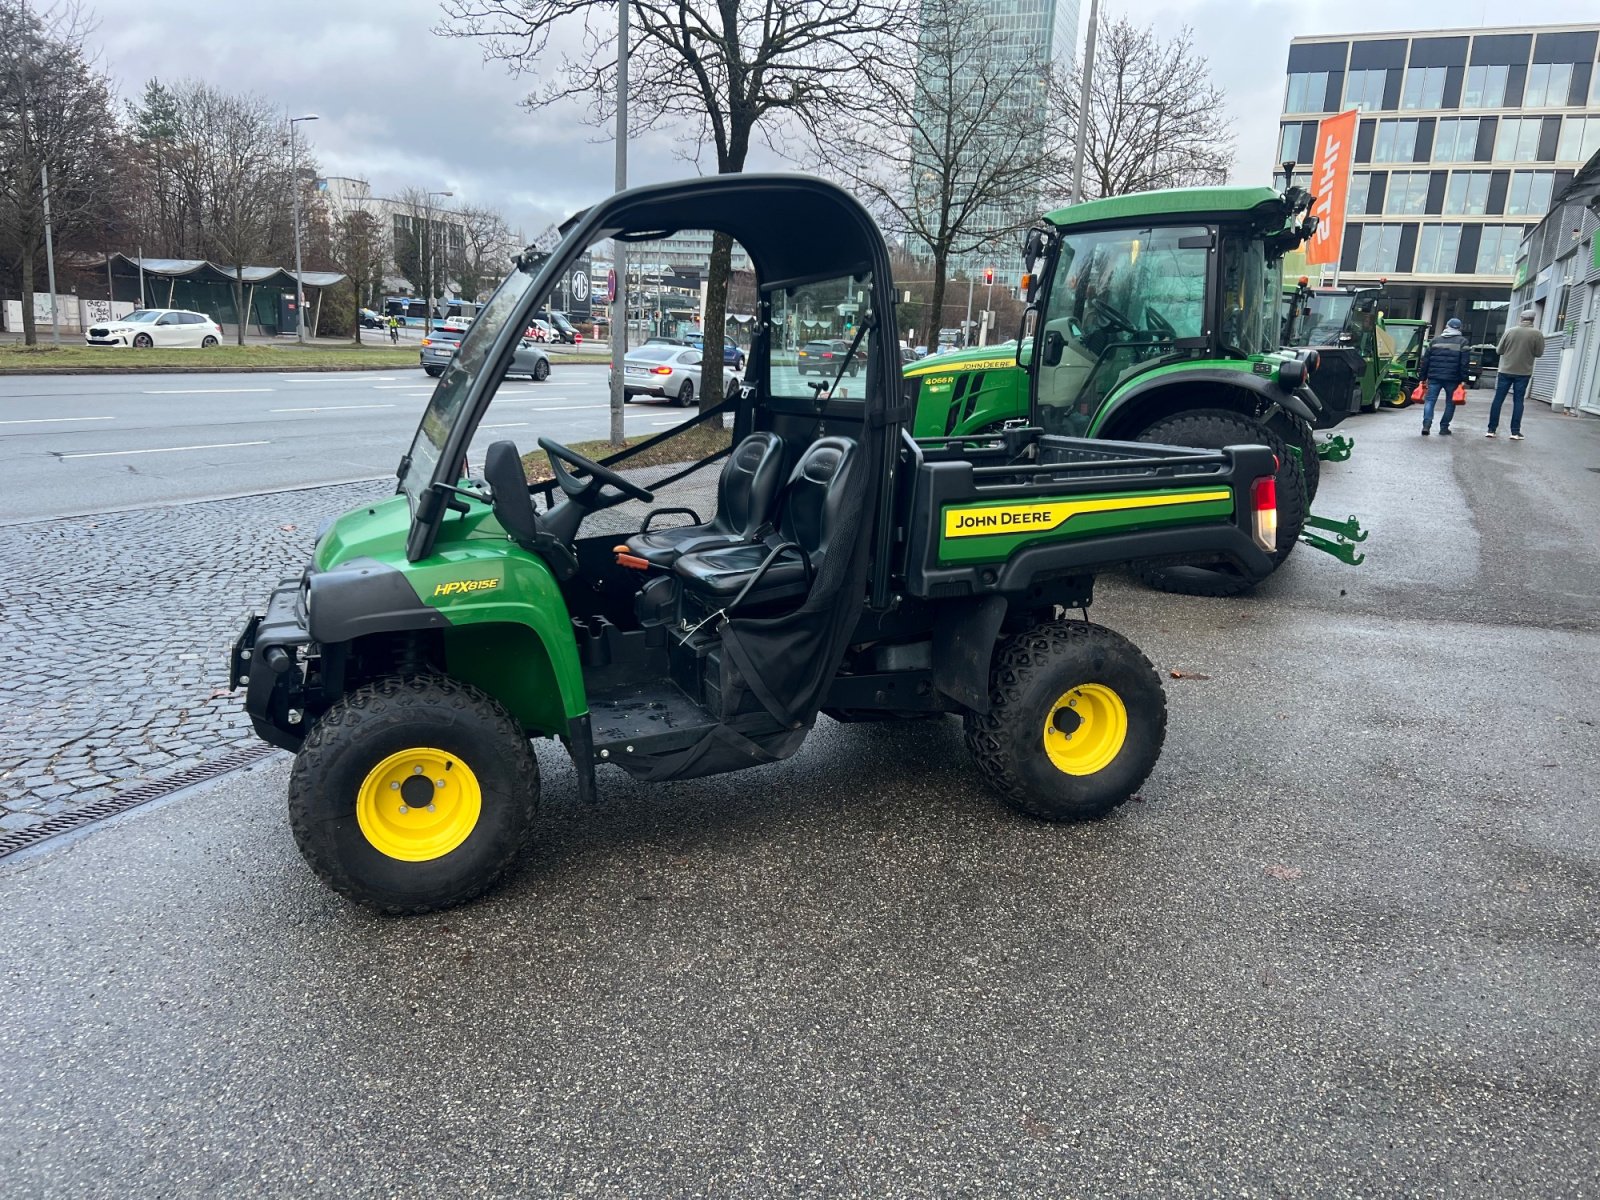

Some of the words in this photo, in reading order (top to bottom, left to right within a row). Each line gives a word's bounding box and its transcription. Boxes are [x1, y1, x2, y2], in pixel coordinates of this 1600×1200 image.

[572, 273, 588, 299] MG
[956, 515, 997, 528] JOHN
[1001, 511, 1052, 525] DEERE
[434, 578, 499, 596] HPX815E
